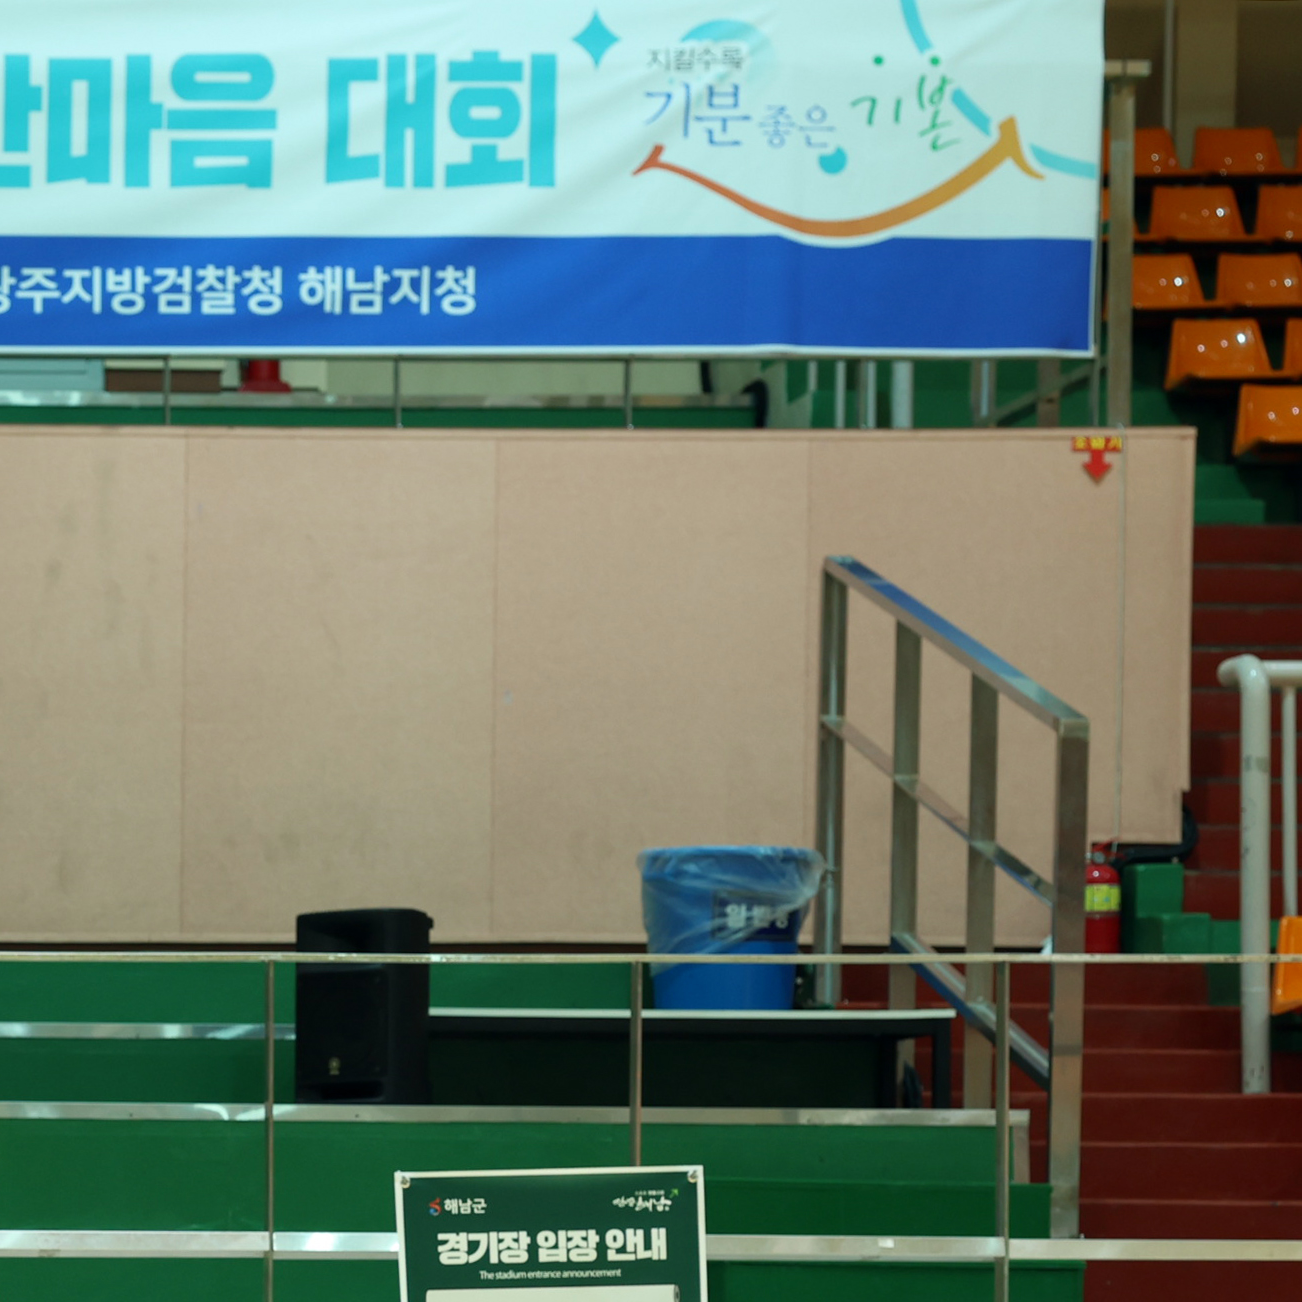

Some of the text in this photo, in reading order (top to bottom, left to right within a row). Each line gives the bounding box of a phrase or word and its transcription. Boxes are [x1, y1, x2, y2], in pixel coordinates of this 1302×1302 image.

[646, 46, 744, 72] 지킬수록
[325, 50, 557, 188] 대회
[644, 74, 963, 151] 기분 좋은 기본
[298, 266, 477, 315] 해남지청
[444, 1198, 487, 1215] 해남군
[437, 1227, 668, 1265] 경기장 입장 안내
[479, 1268, 622, 1280] The stadium entrance announcement
